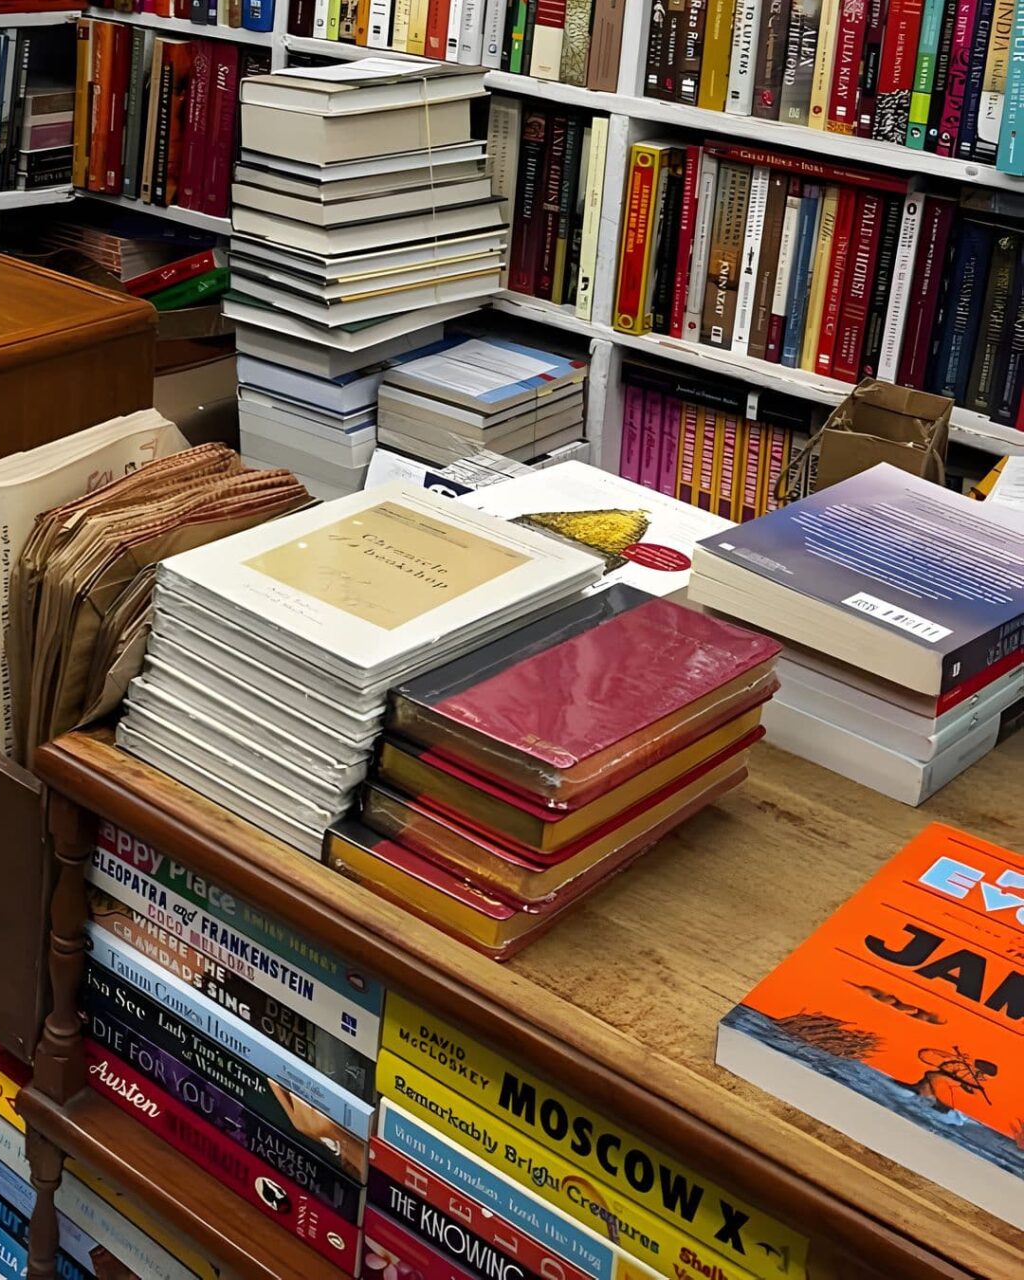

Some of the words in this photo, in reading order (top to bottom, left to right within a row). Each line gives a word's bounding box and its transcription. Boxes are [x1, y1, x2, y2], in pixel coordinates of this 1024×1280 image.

[746, 2, 756, 18] TO
[993, 1, 1014, 53] INDIA
[738, 20, 753, 76] LUTYENS
[799, 27, 818, 70] ALEX
[843, 29, 857, 62] JULIA
[362, 548, 449, 590] bookshop
[100, 820, 164, 875] appy
[90, 848, 168, 911] CLEOPATRA
[172, 902, 199, 927] and
[201, 916, 315, 1002] FRANKENSTEIN
[130, 908, 189, 958] WHERE
[195, 945, 226, 984] THE
[113, 919, 204, 990] CRAWDADS
[205, 978, 252, 1022] SING
[418, 1024, 467, 1061] DAVID
[88, 1058, 162, 1119] Austen
[129, 1043, 166, 1079] FOR
[175, 1077, 215, 1115] YOU
[256, 1125, 318, 1179] LAUREN
[393, 1075, 498, 1156] Remarkably
[504, 1144, 561, 1194] Bright
[566, 1183, 661, 1256] Creatures
[497, 1072, 706, 1224] MOSCOW
[713, 1197, 757, 1257] X
[388, 1185, 417, 1223] THE
